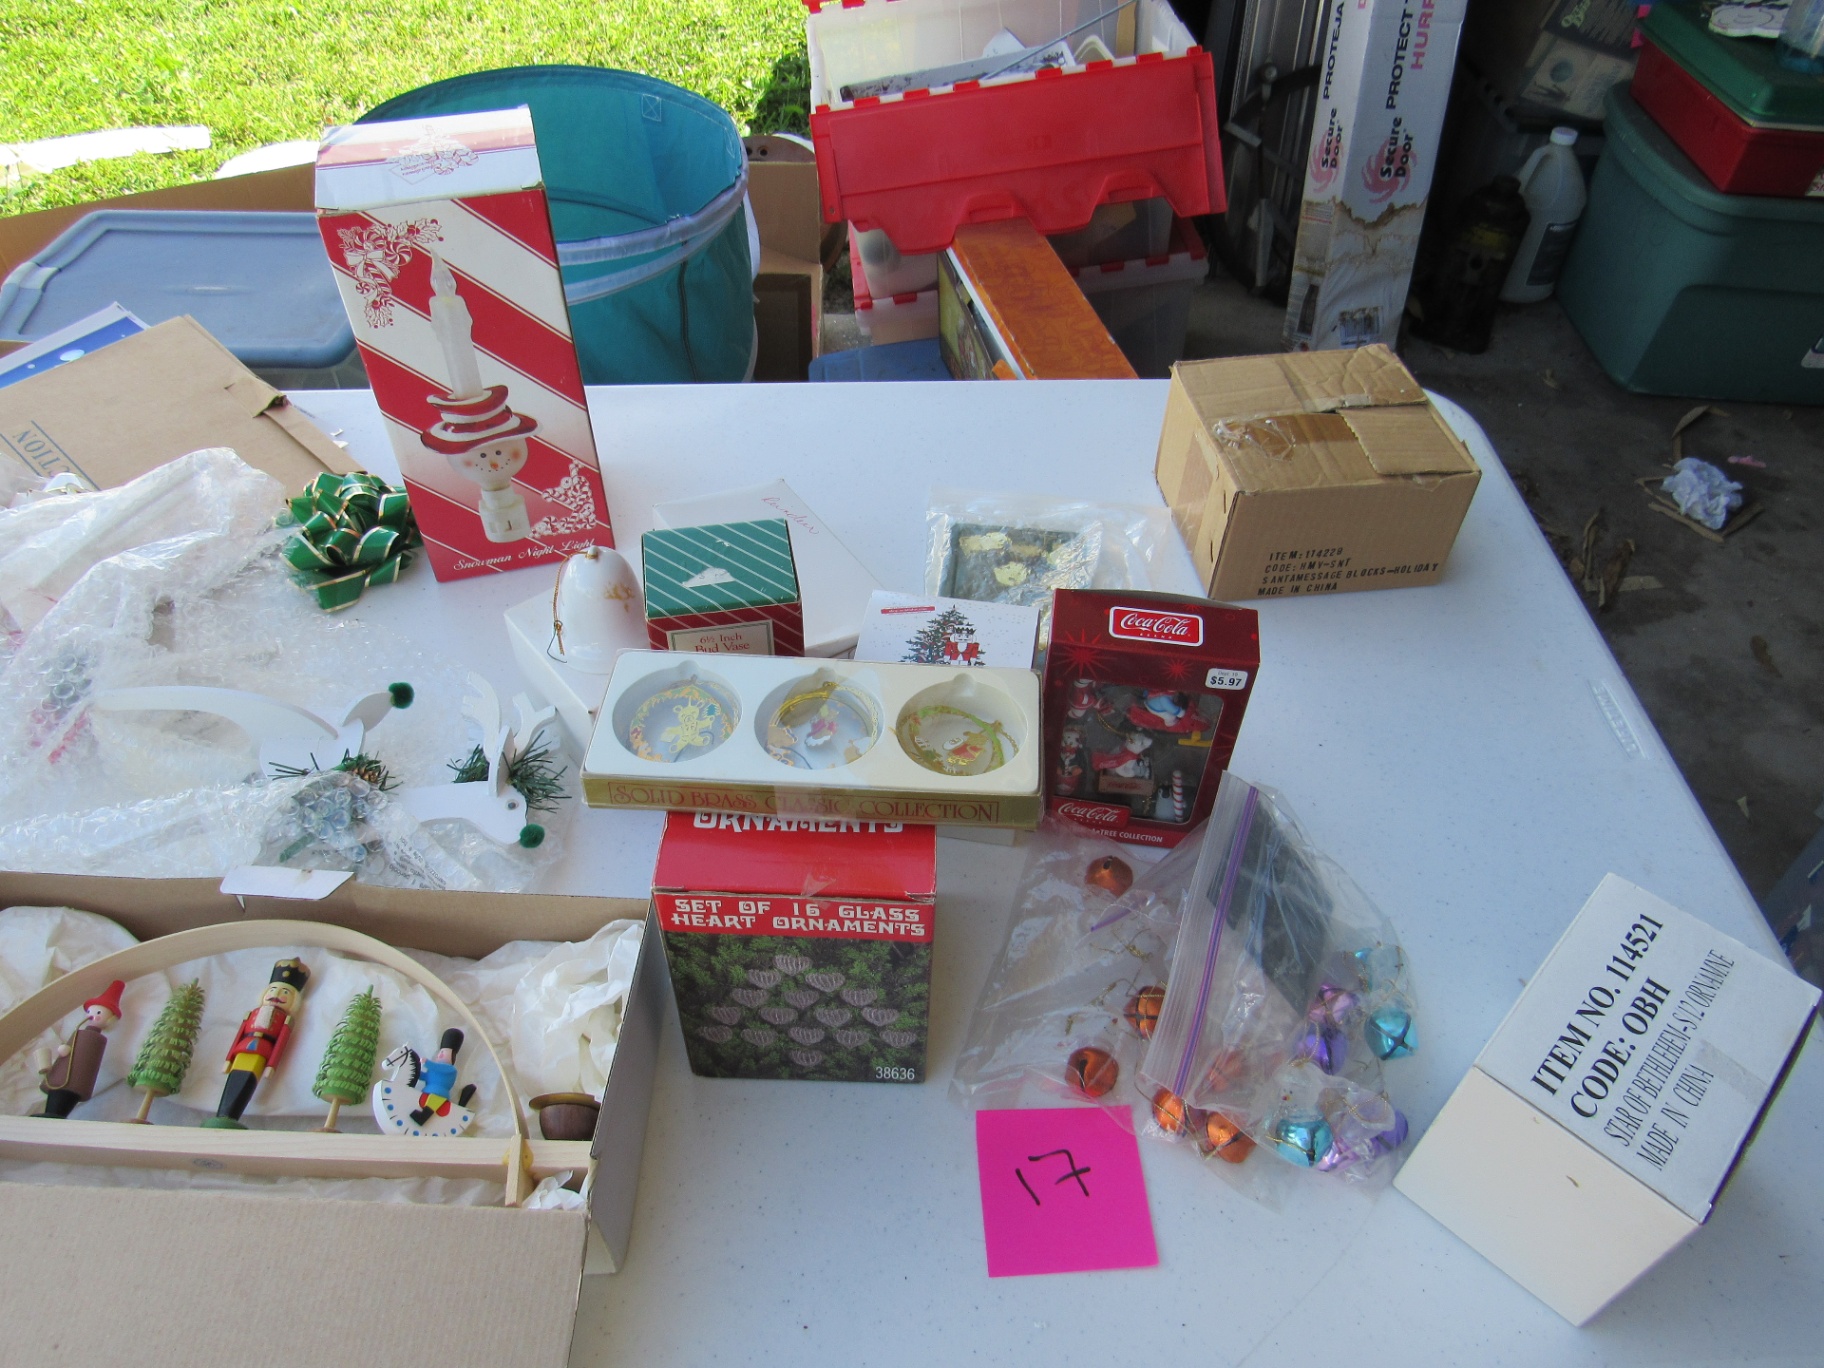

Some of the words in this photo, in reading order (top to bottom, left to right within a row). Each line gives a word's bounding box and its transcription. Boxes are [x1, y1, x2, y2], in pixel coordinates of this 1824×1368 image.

[1323, 2, 1345, 100] PROTEJA
[1386, 10, 1414, 110] PROTECT
[1321, 107, 1337, 169] Secure
[1329, 125, 1343, 169] Door
[1379, 116, 1402, 178] Secure
[1394, 133, 1414, 178] Door
[453, 555, 513, 571] Snowman
[518, 545, 555, 560] Night
[561, 538, 596, 552] Light
[1265, 564, 1297, 574] CODE:
[1257, 586, 1284, 597] MADE
[1290, 585, 1301, 594] IN
[1306, 582, 1339, 593] CHINA
[694, 643, 720, 653] Bud
[723, 641, 751, 652] Vase
[719, 632, 743, 643] Inch
[1209, 675, 1243, 688] $5.97
[613, 785, 686, 806] SOLID
[692, 789, 758, 811] BRASS
[858, 799, 994, 822] COLLECTION
[1119, 831, 1164, 843] COLLECTION
[671, 913, 756, 930] HEART
[772, 916, 926, 937] ORNAMENTS
[675, 899, 722, 914] SET
[738, 900, 771, 915] OF
[792, 903, 820, 917] 16
[838, 905, 921, 923] GLASS
[1530, 1021, 1593, 1096] ITEM
[1574, 985, 1622, 1028] NO.
[1605, 913, 1664, 983] 114521
[1570, 1036, 1637, 1119] CODE:
[1621, 976, 1672, 1036] OBH
[875, 1066, 915, 1080] 38636
[1672, 1063, 1715, 1108] CHINA
[1622, 1086, 1653, 1116] OF
[1660, 1101, 1691, 1130] IN
[1603, 1105, 1645, 1148] STAR
[1635, 1122, 1680, 1172] MADE
[1015, 1148, 1091, 1206] 17
